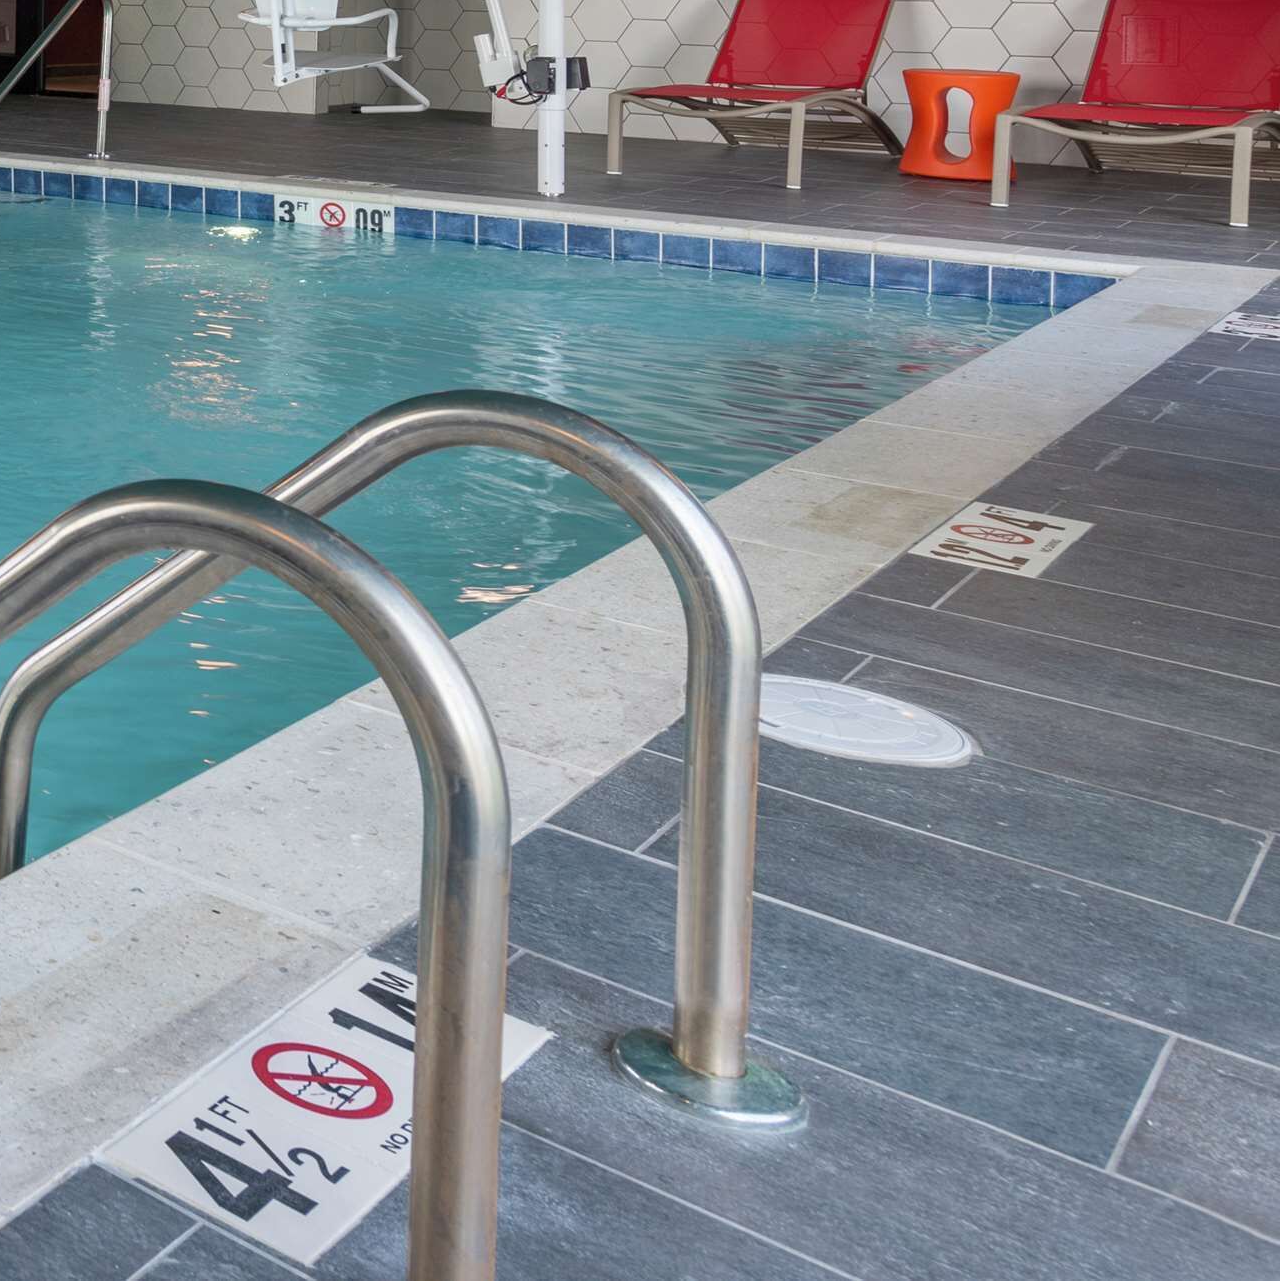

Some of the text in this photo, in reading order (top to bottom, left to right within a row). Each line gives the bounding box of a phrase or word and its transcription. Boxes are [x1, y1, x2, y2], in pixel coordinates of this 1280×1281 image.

[372, 971, 415, 994] M
[207, 1094, 251, 1124] FT
[379, 1132, 410, 1155] NO
